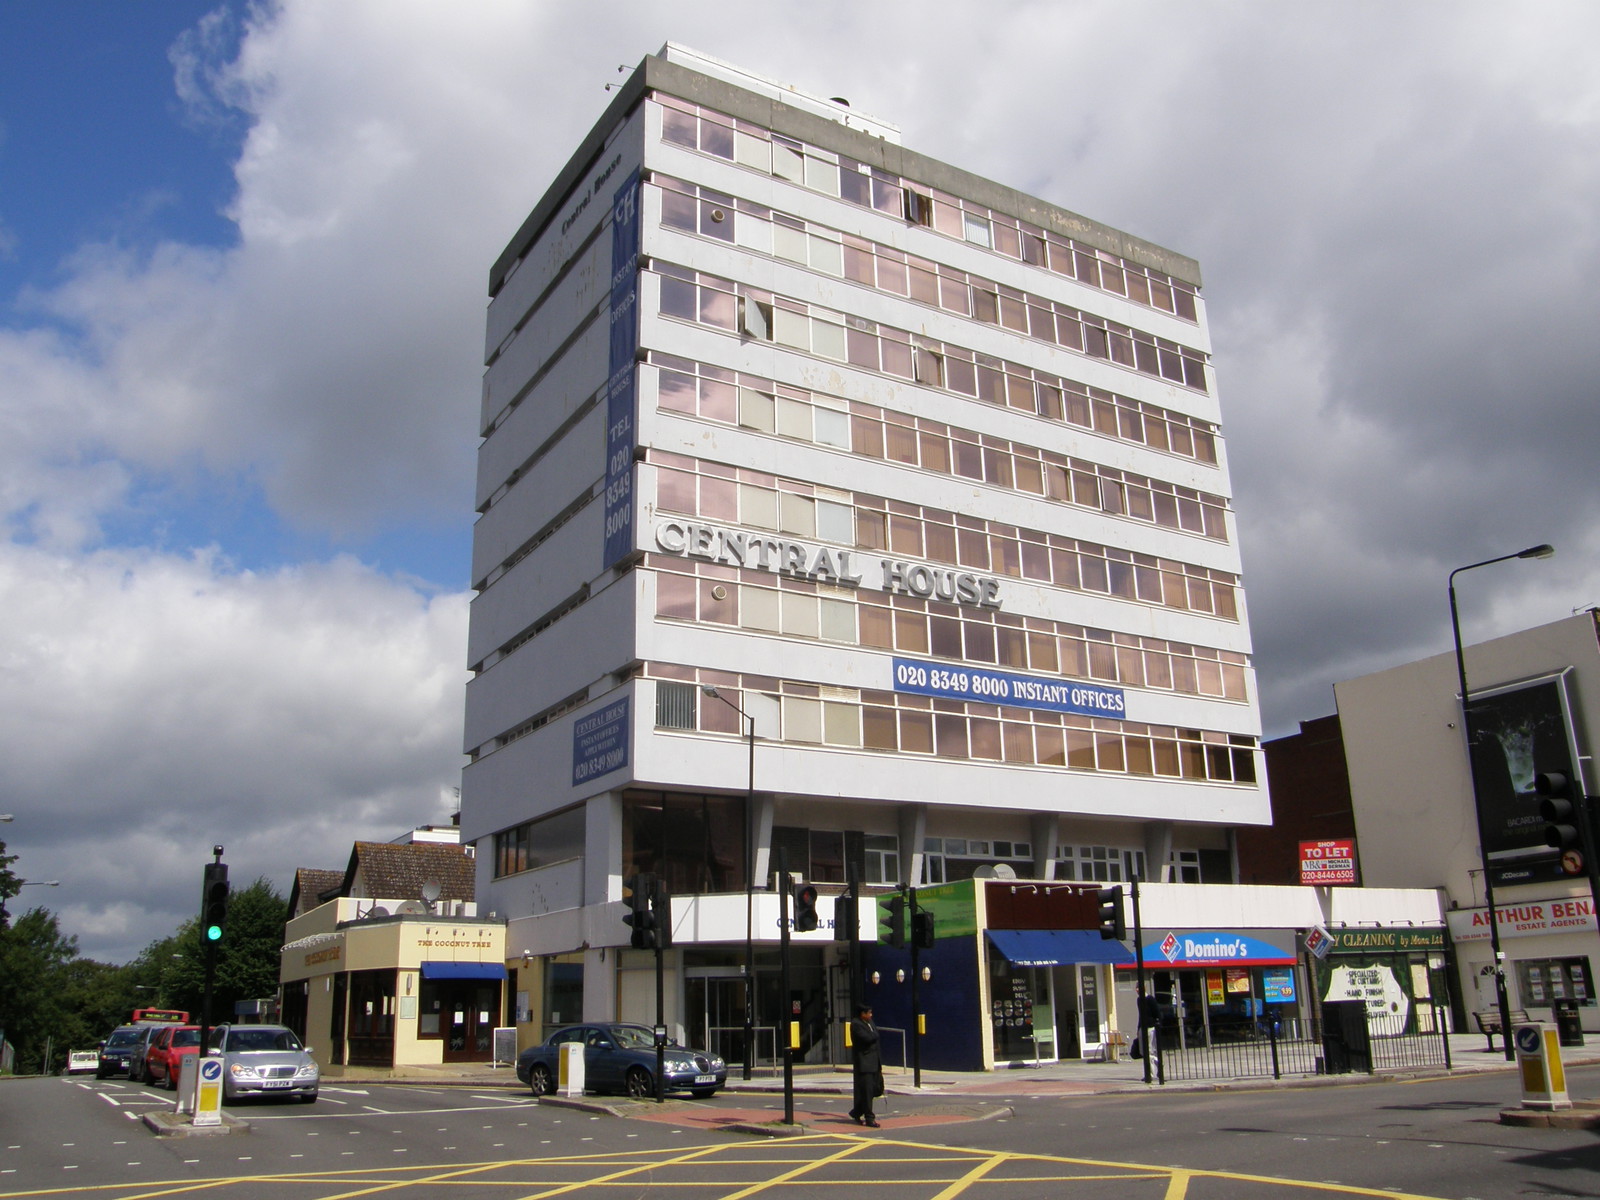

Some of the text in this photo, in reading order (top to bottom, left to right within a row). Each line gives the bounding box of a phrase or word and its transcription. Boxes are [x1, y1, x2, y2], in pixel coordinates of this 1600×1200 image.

[616, 182, 638, 226] CH
[612, 253, 637, 289] INSTANT
[610, 289, 636, 324] OFFICES
[610, 415, 631, 442] TEL
[611, 445, 629, 476] 020
[606, 471, 630, 508] 8349
[606, 503, 630, 538] 8000
[655, 519, 1003, 609] CENTRAL HOUSE
[898, 664, 1124, 711] 020 8349 8000 INSTANT OFFICES
[576, 714, 604, 734] CENTRAL
[575, 761, 589, 780] 020
[589, 754, 606, 775] 8349
[1304, 847, 1349, 858] TO LET
[1336, 870, 1354, 878] 6505
[1516, 918, 1587, 931] ESTATE AGENTS
[1185, 937, 1248, 958] Domino's
[1343, 933, 1396, 946] CLEANING
[1400, 935, 1409, 947] by
